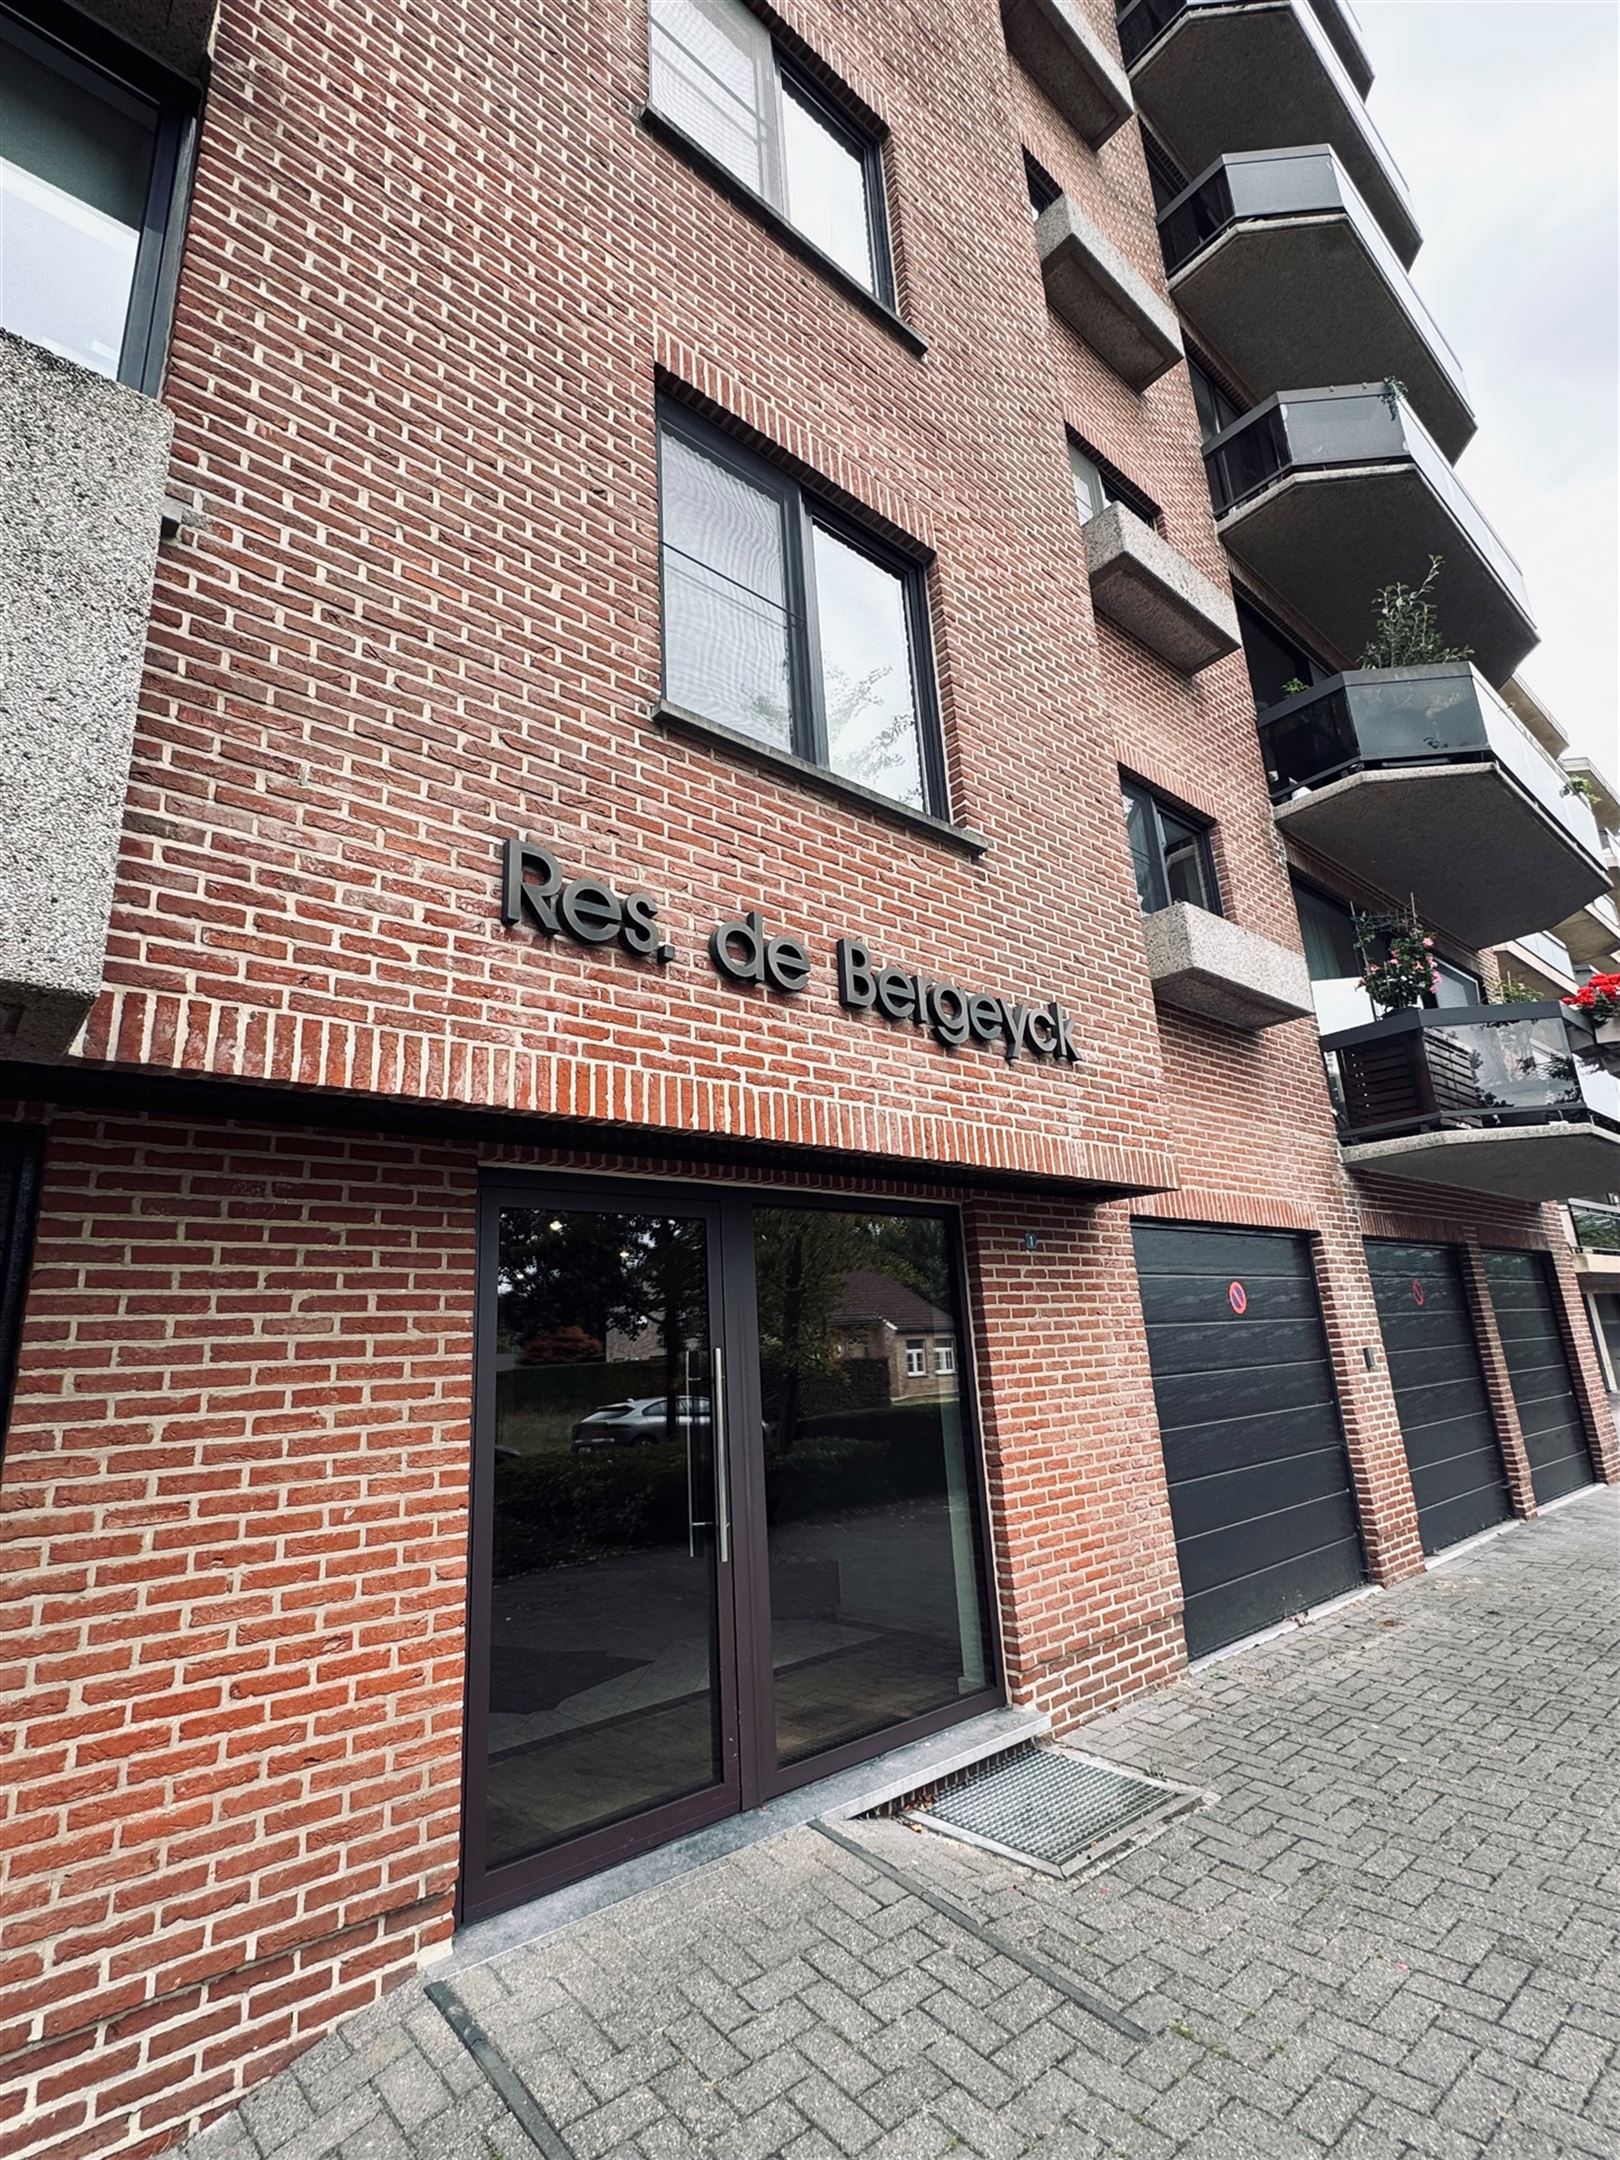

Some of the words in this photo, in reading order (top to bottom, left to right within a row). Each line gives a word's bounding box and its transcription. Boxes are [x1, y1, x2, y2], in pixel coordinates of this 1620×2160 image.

[502, 839, 676, 963] Res.
[710, 912, 811, 992] de
[837, 938, 1082, 1062] Bergeyck
